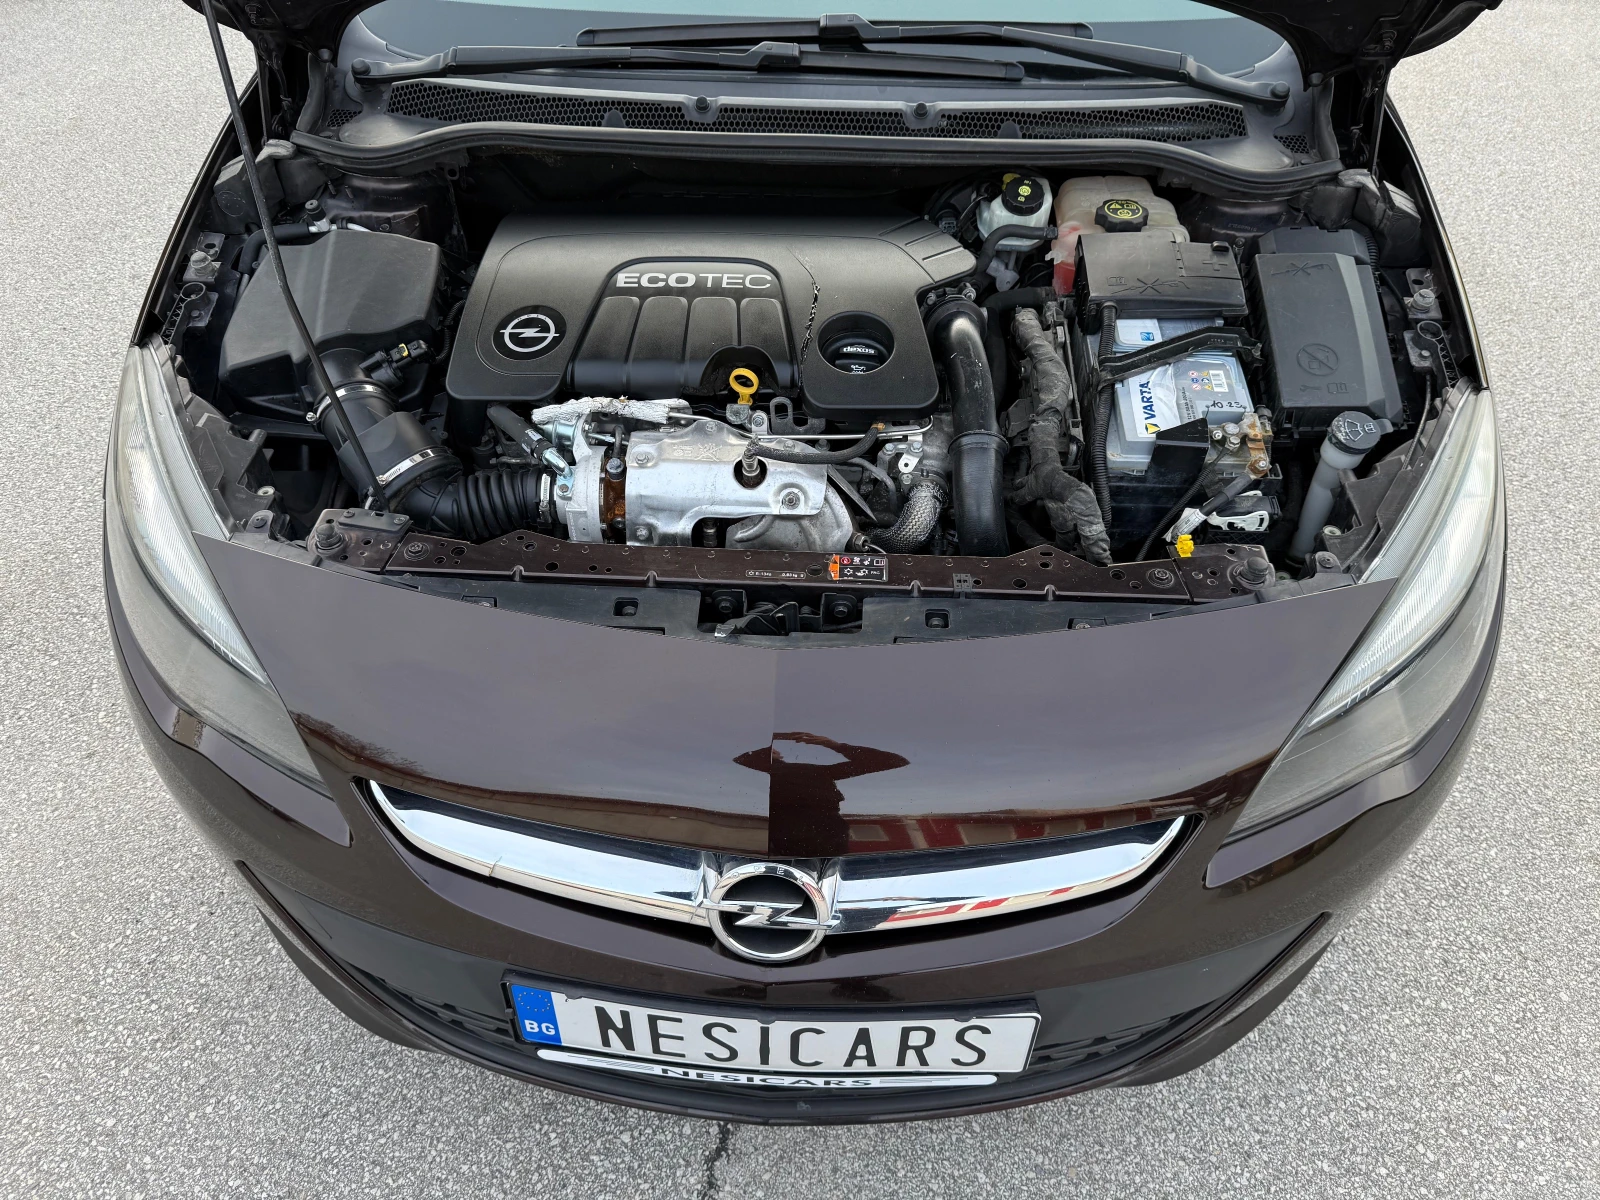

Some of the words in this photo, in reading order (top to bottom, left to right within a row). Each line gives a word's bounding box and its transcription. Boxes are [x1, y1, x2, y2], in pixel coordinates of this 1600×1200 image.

[616, 272, 772, 290] ECOTEC
[843, 345, 875, 354] dexos
[1139, 380, 1156, 420] VARTA
[730, 865, 804, 885] OPEL
[524, 1019, 556, 1037] BG
[594, 1005, 992, 1068] NESICARS
[660, 1068, 873, 1088] NESICARS
